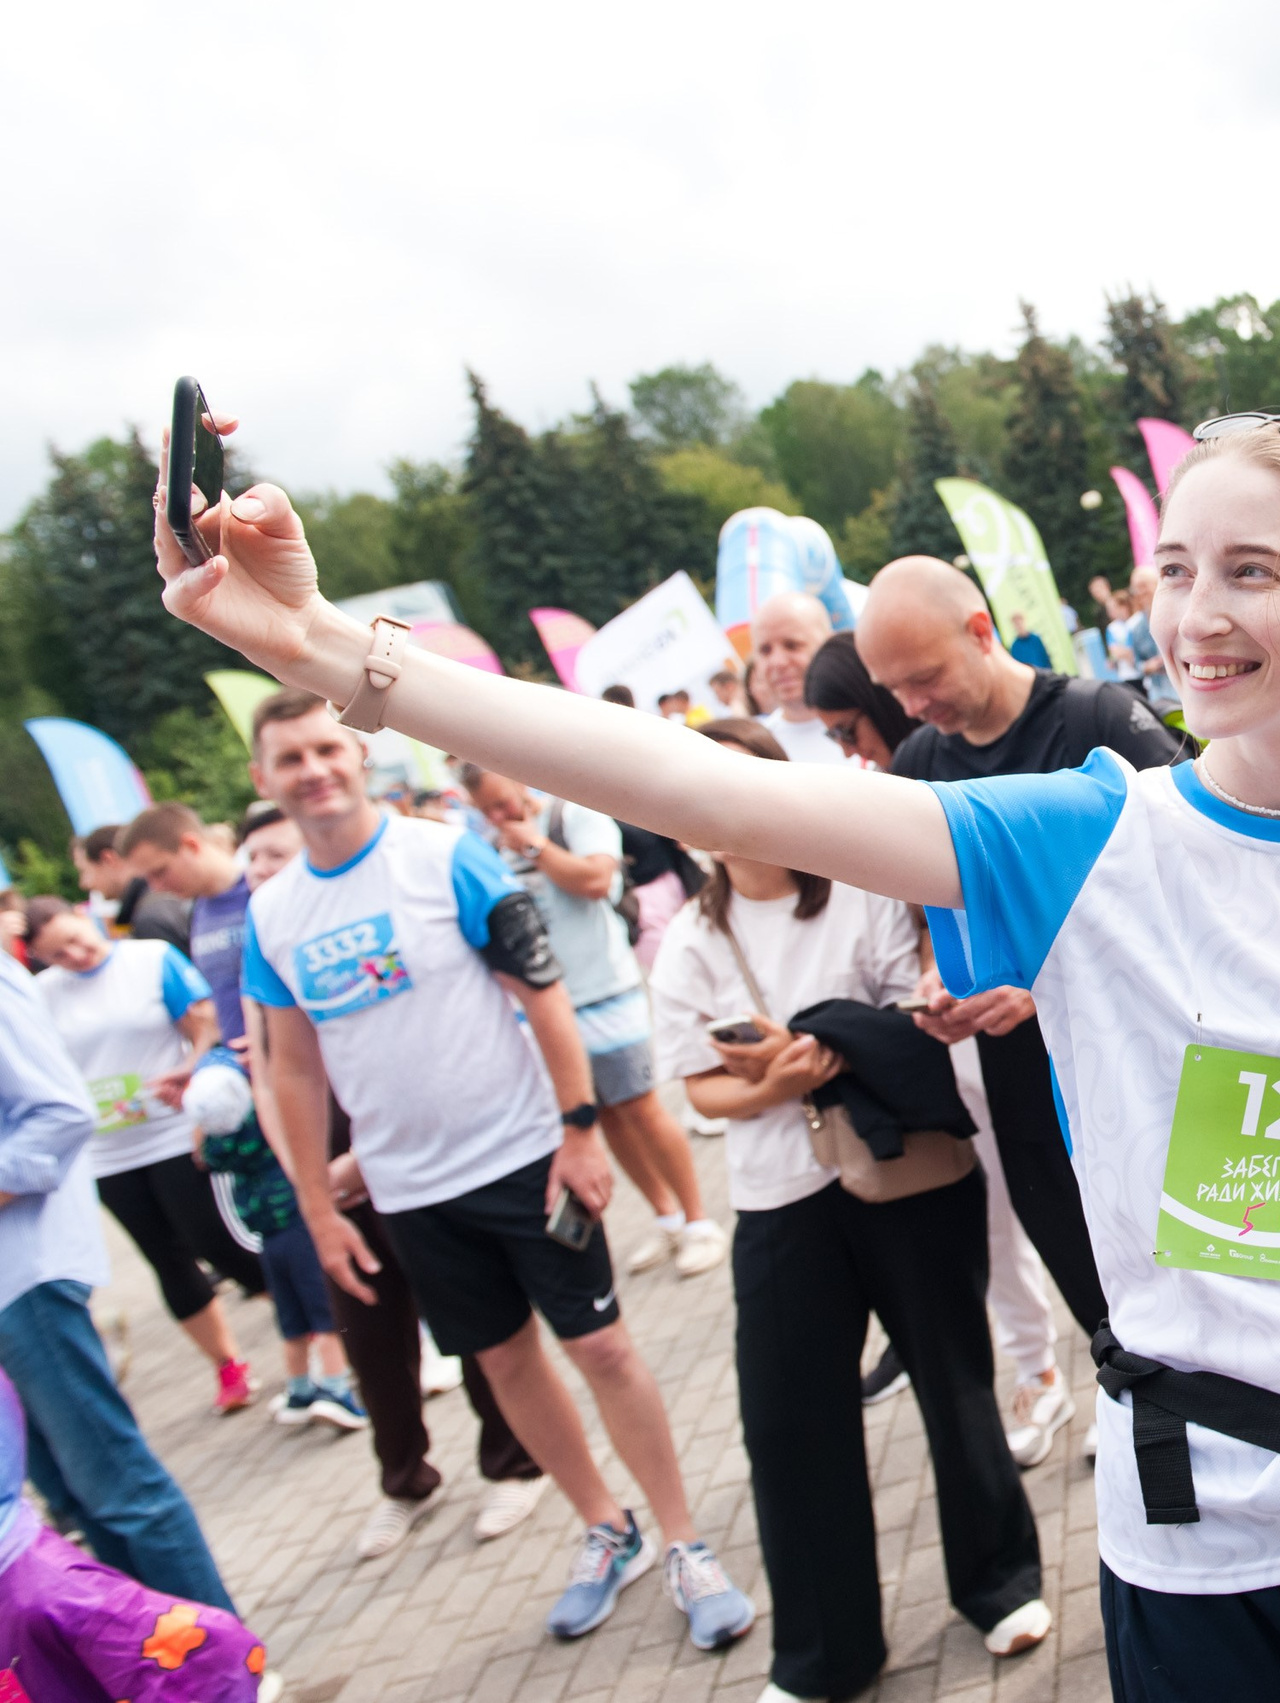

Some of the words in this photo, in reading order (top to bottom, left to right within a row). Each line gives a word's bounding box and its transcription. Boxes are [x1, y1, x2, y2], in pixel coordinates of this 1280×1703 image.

[302, 922, 381, 973] 3332
[1196, 1180, 1246, 1203] РАДИ
[1238, 1202, 1267, 1237] 5
